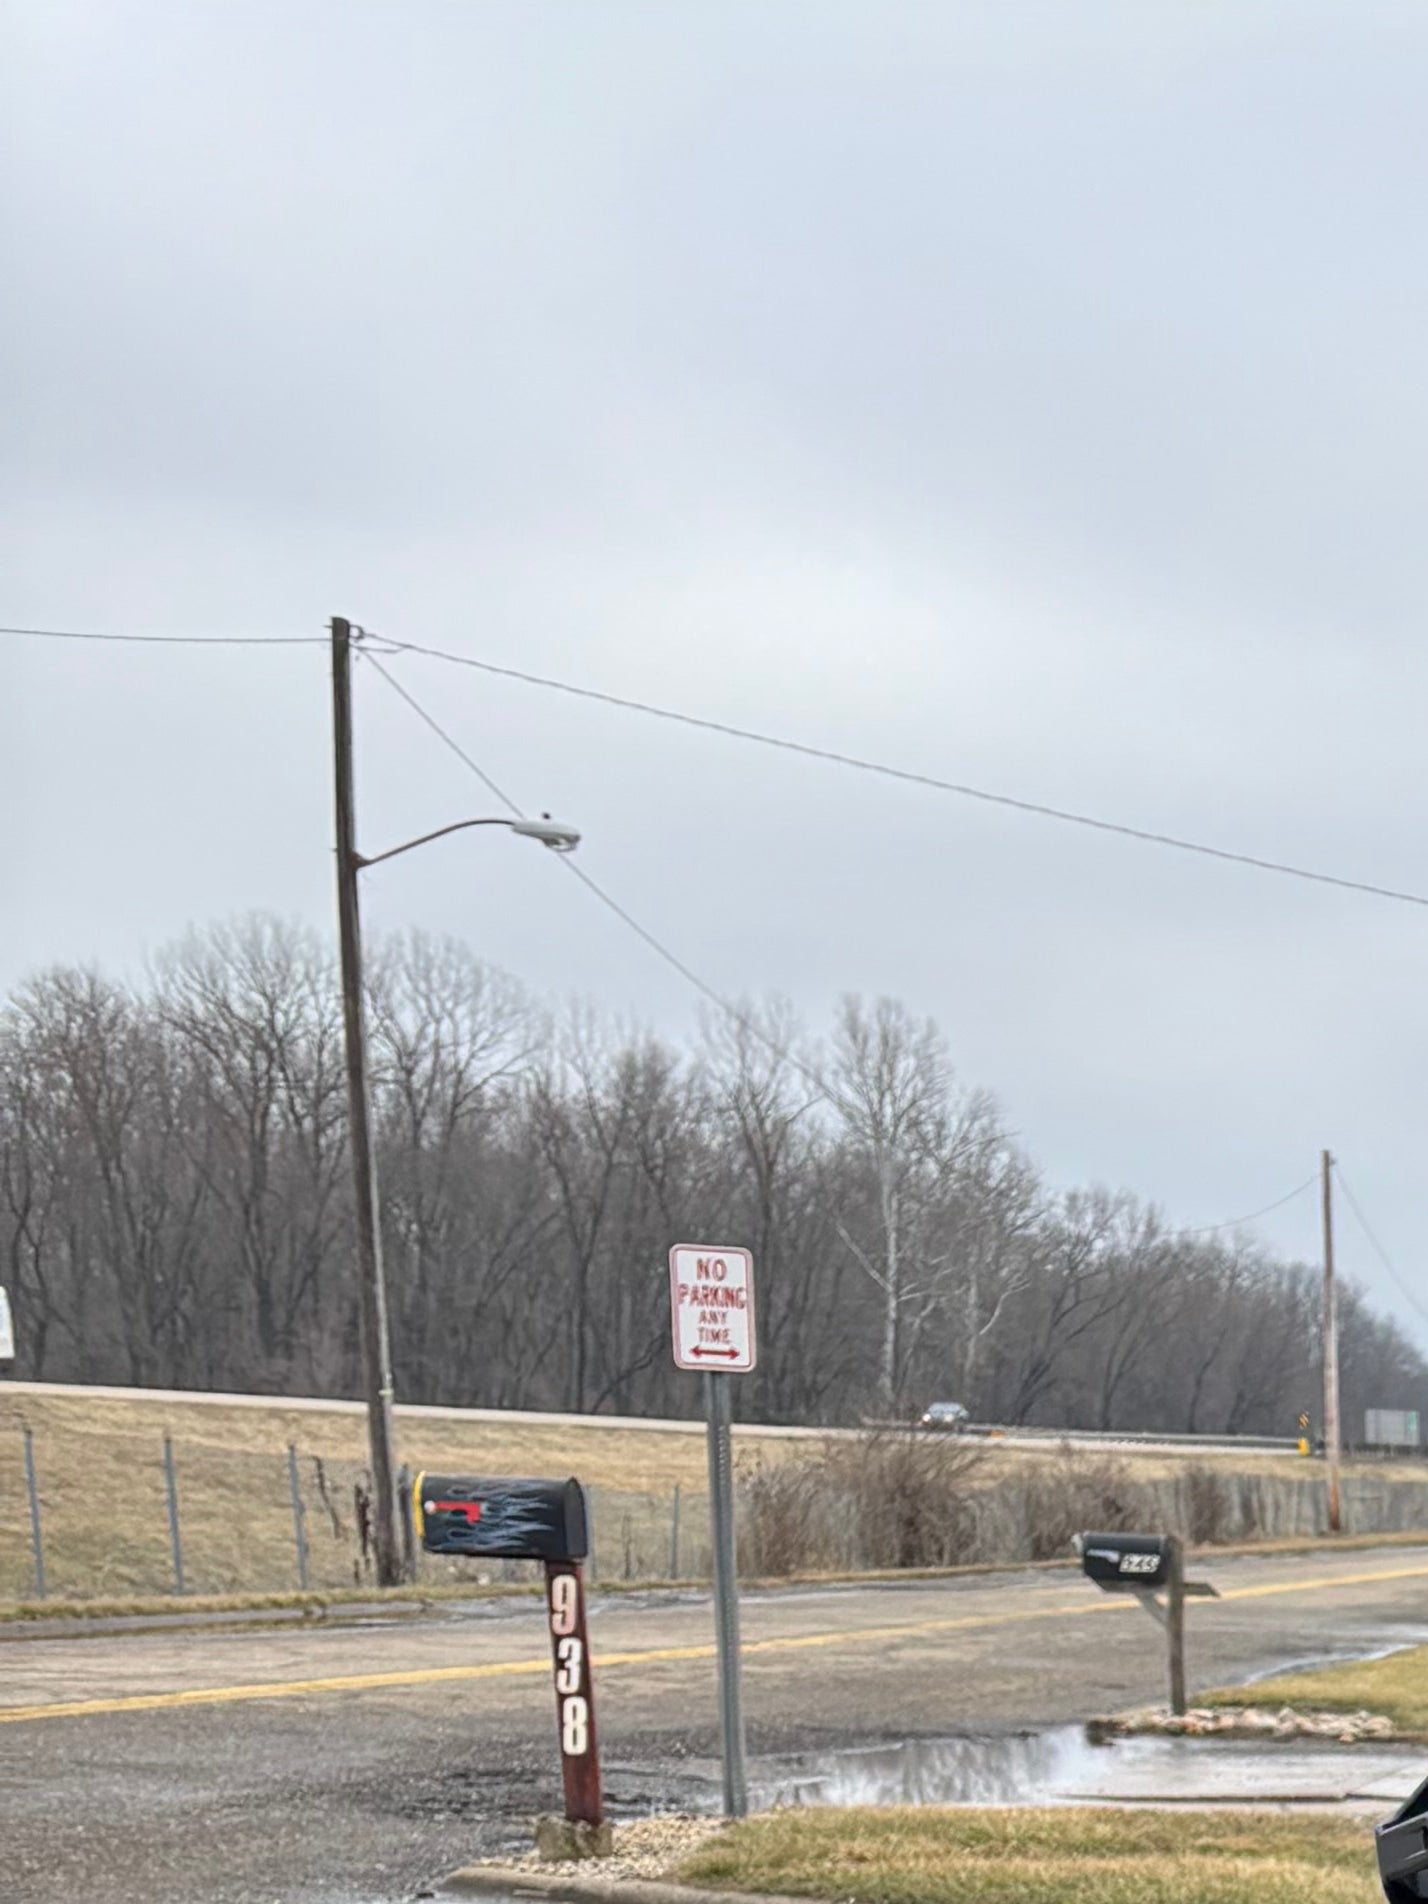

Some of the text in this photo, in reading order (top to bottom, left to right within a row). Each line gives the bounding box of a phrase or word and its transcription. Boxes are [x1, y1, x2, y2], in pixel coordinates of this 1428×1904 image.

[696, 1258, 727, 1282] NO
[678, 1283, 747, 1310] PARKING
[698, 1310, 728, 1325] ANY
[697, 1327, 731, 1345] TIME
